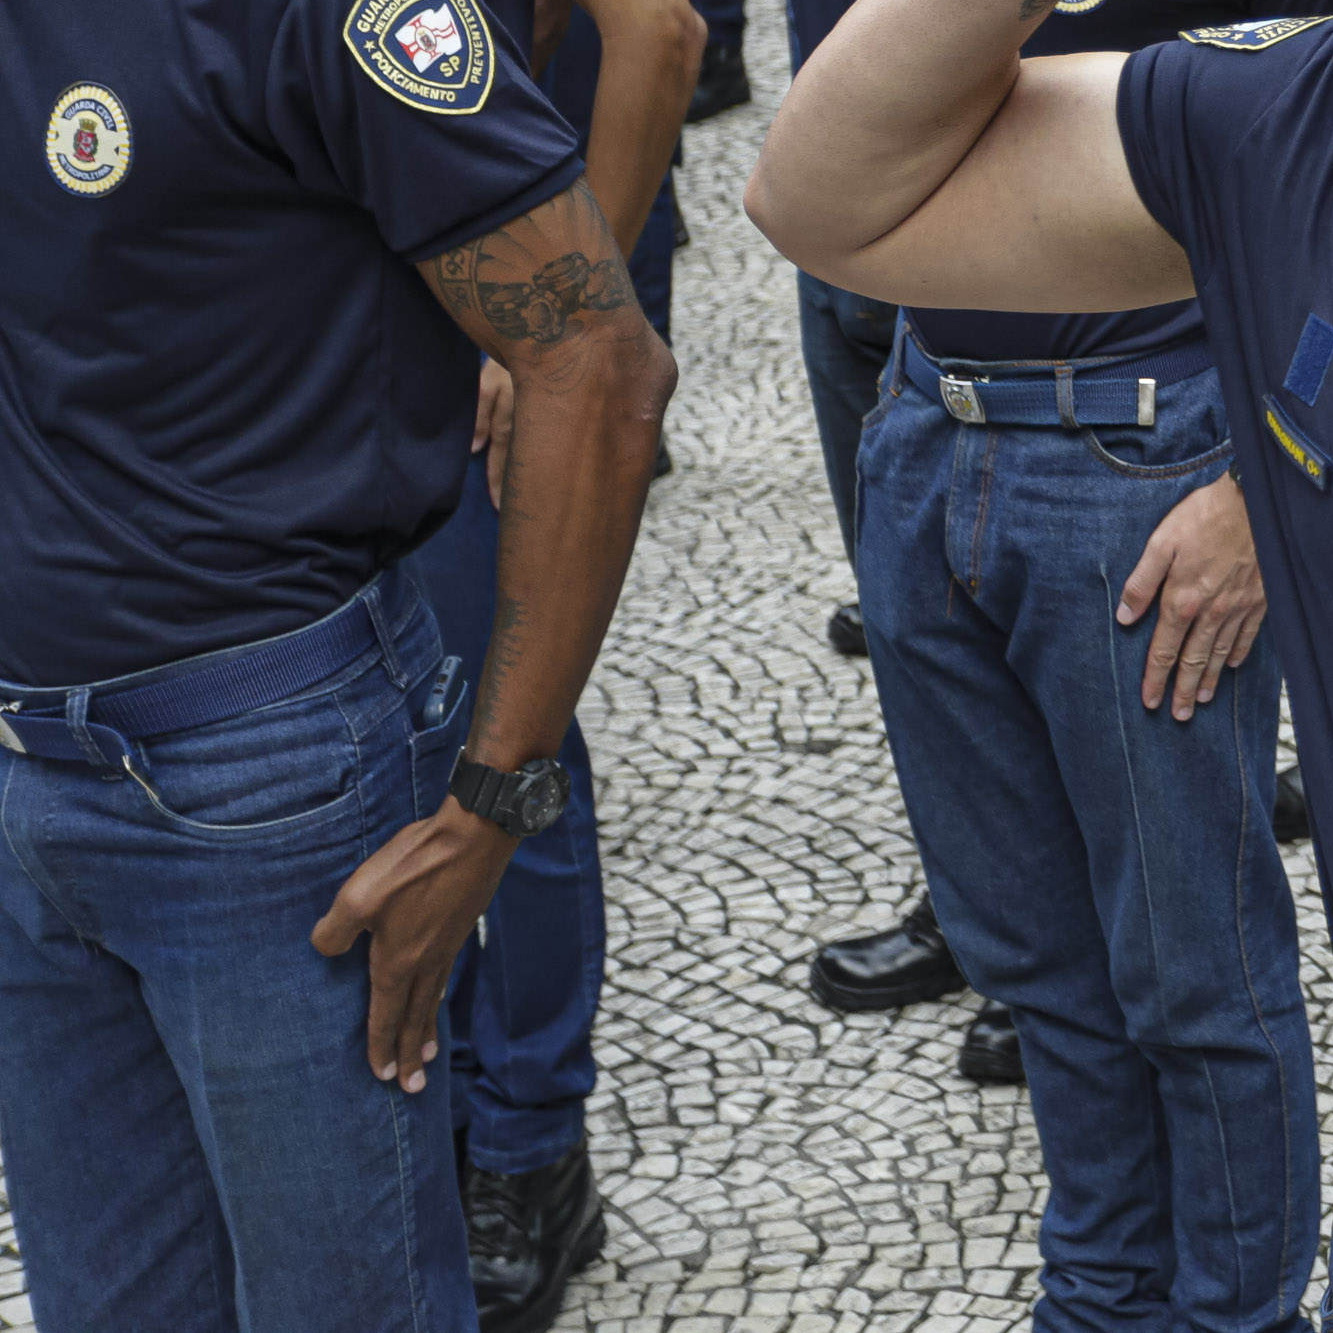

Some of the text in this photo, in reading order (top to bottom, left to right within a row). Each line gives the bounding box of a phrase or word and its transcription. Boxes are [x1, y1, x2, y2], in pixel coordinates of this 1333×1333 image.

[371, 51, 456, 102] POLICIAMENTO
[439, 56, 461, 77] SP
[65, 101, 95, 119] GUARDA
